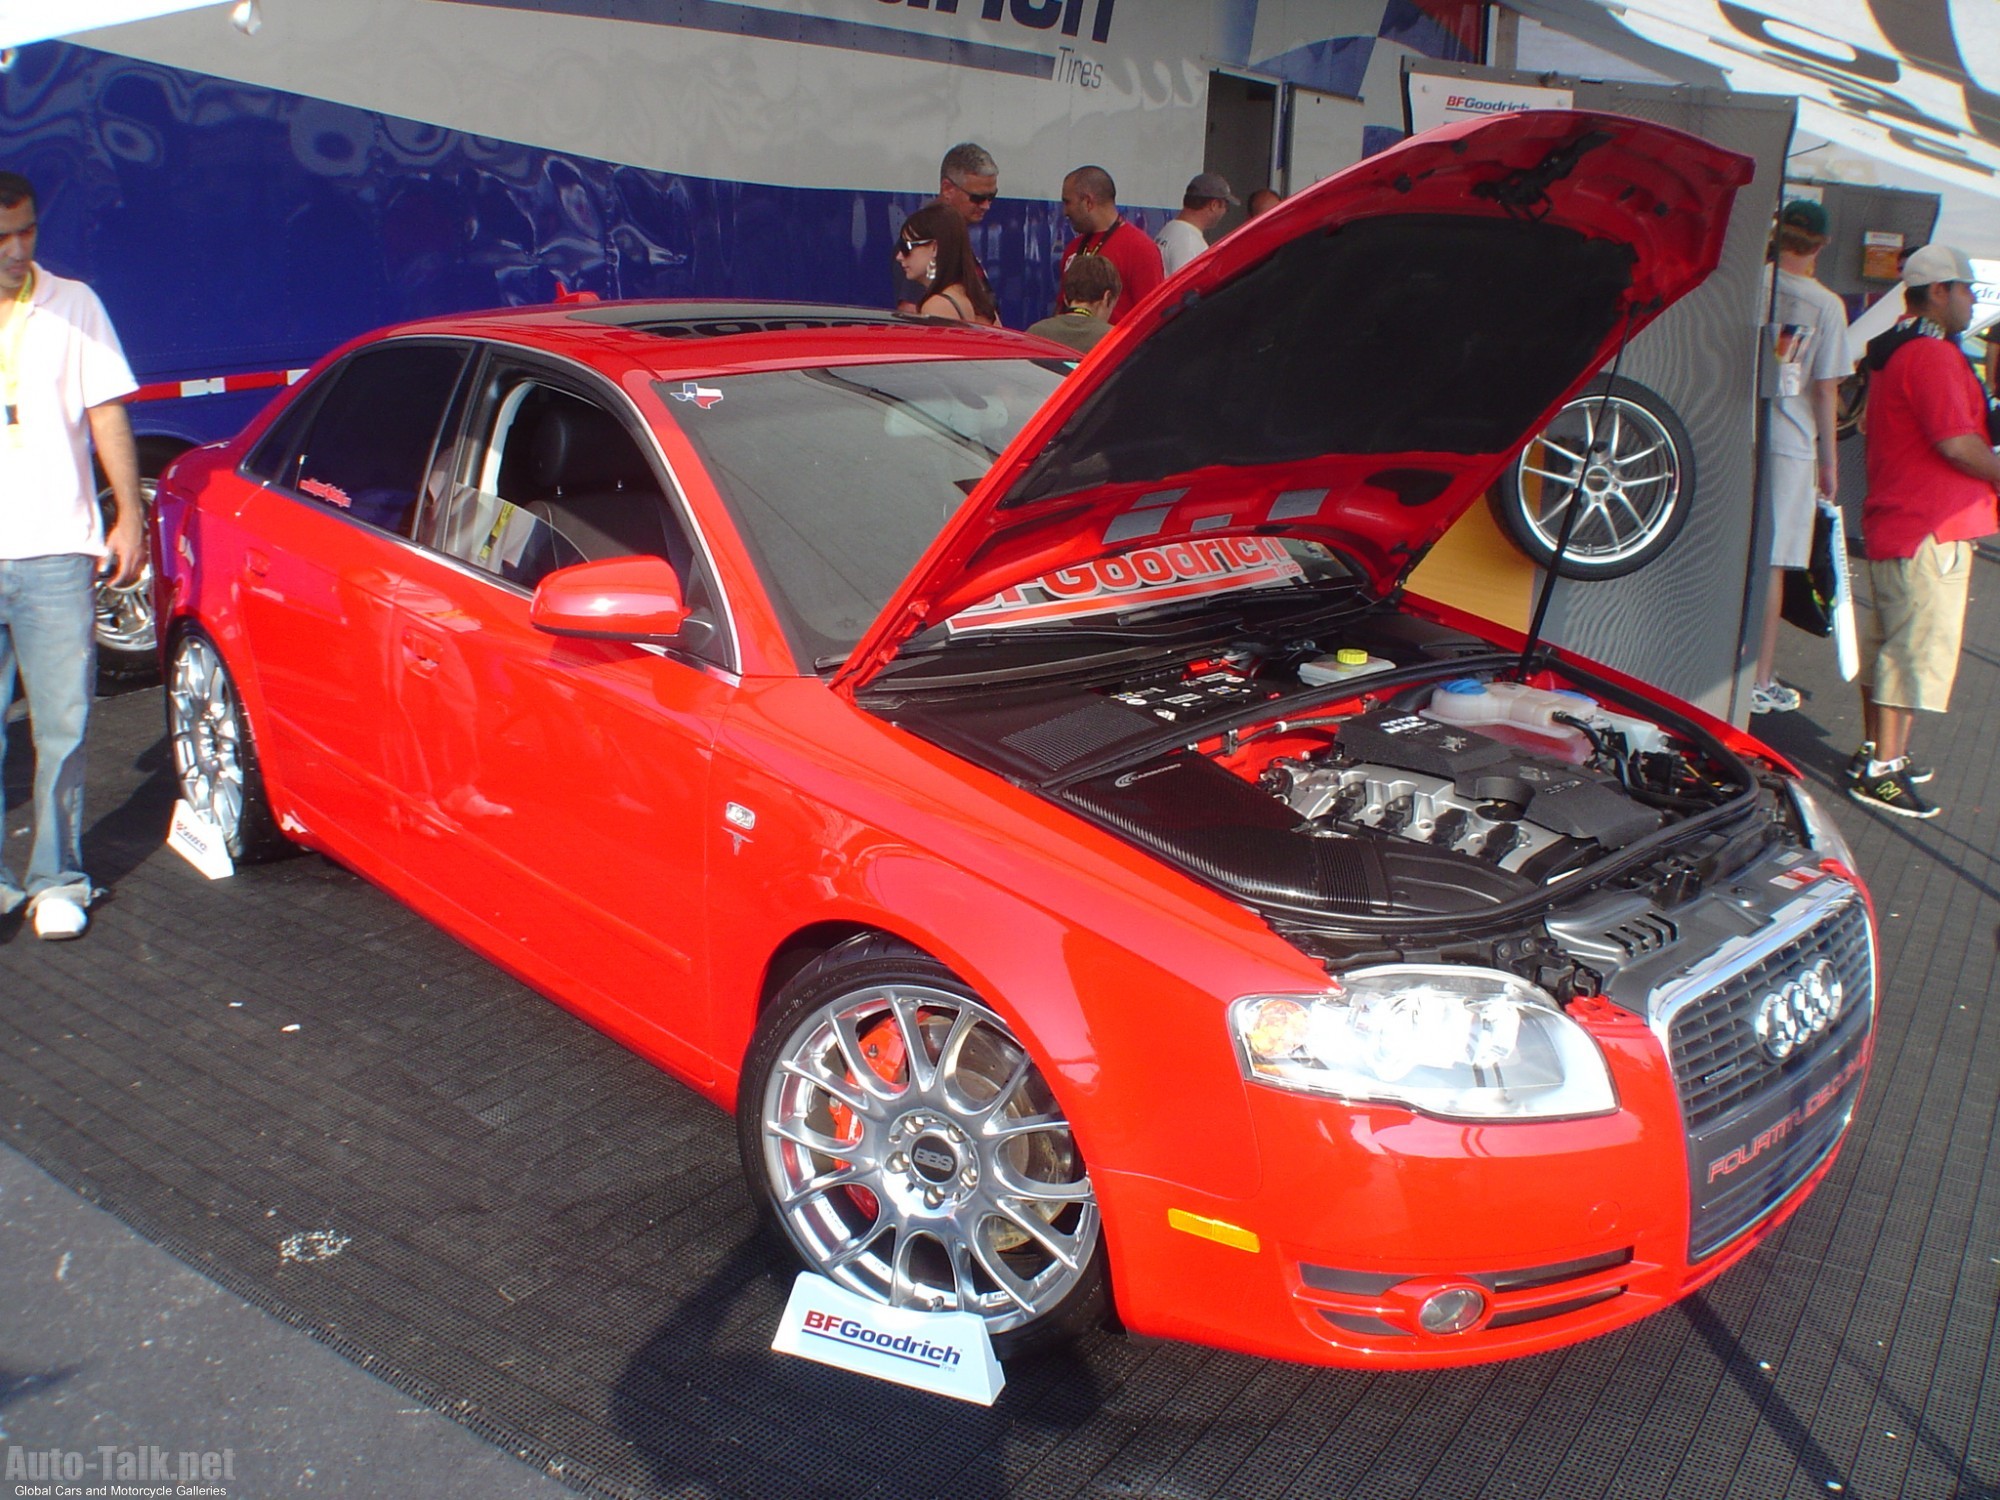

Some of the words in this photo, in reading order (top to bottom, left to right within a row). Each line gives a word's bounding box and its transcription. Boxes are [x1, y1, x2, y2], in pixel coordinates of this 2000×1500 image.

[1058, 46, 1103, 89] Tires
[1446, 95, 1530, 112] BFGoodrich
[913, 1147, 955, 1172] BBS
[804, 1309, 960, 1365] BFGoodrich
